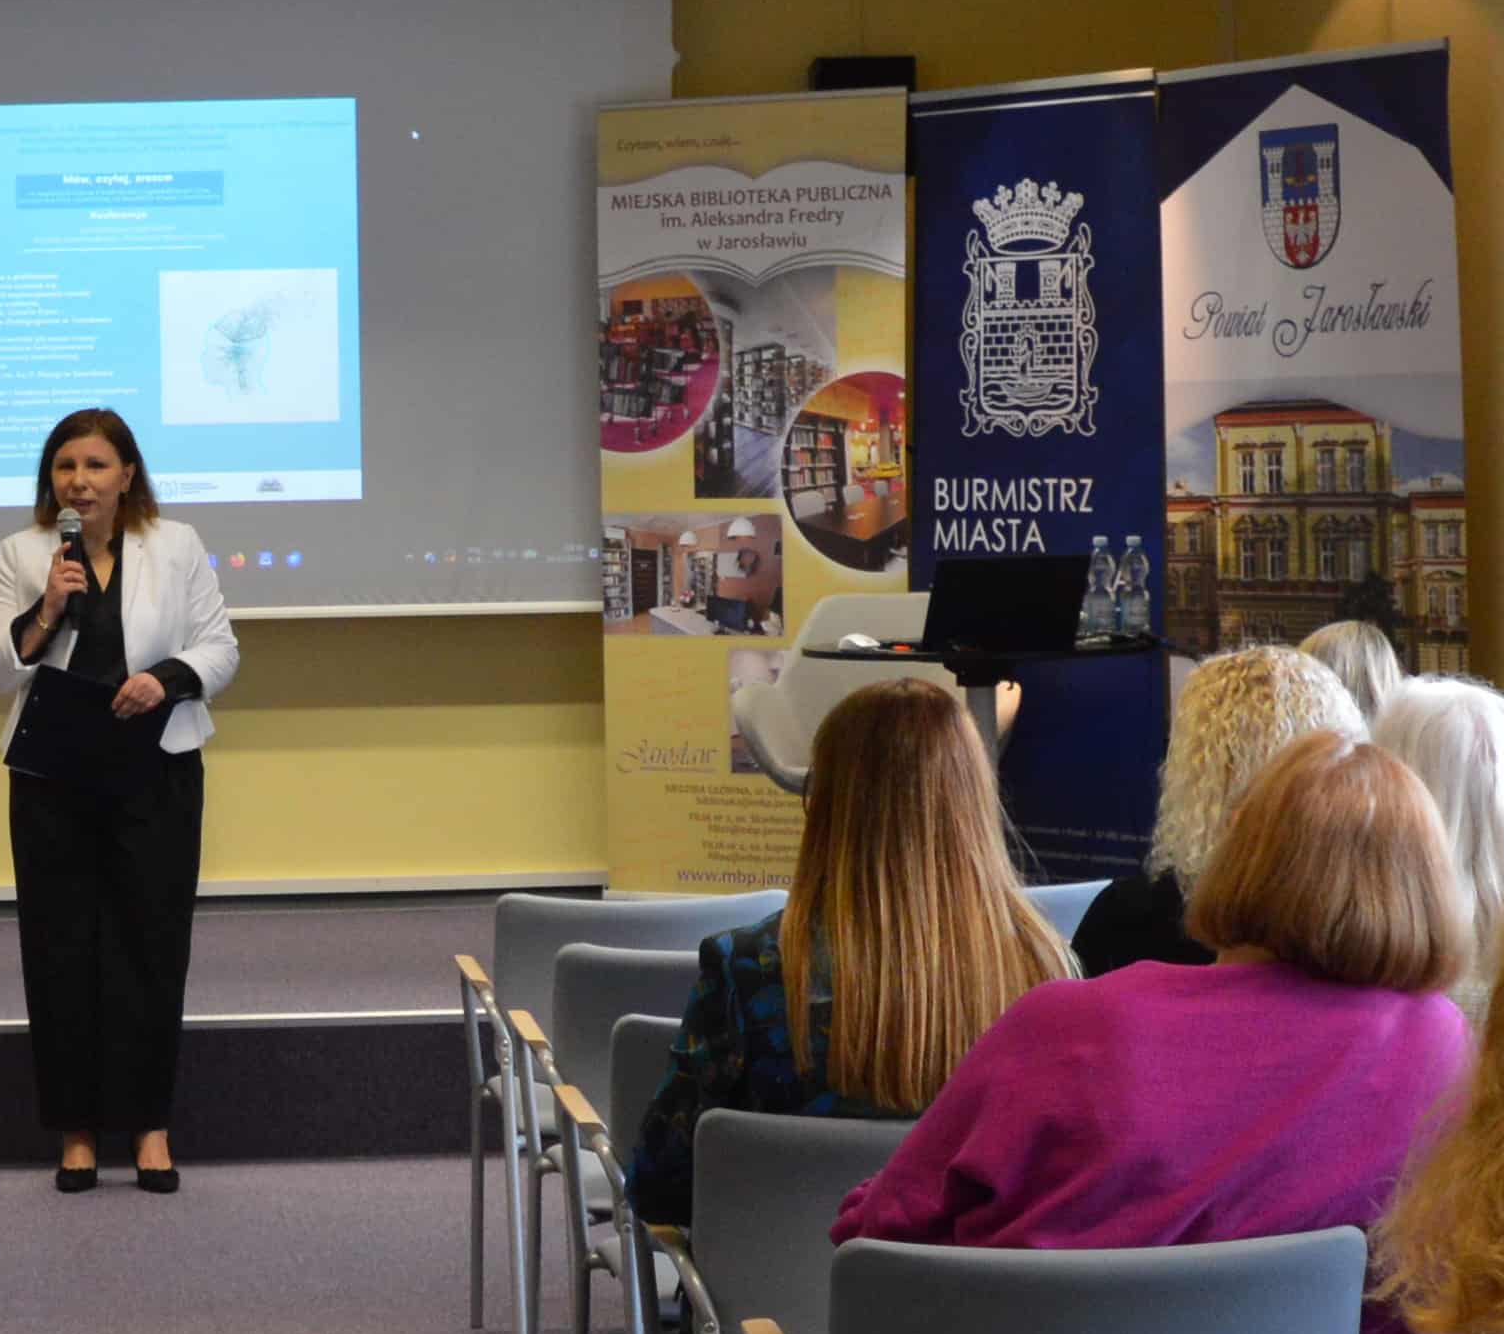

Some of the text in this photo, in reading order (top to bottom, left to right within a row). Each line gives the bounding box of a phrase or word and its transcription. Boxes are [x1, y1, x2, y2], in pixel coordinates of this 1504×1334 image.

[611, 184, 892, 211] MIEJSKA BIBLIOTEKA PUBLICZNA
[661, 207, 844, 228] im. Aleksandra Fredry
[697, 232, 807, 251] w Jarosławiu
[1183, 278, 1433, 357] Powiat Jarosławski
[933, 477, 1094, 513] BURMISTRZ
[933, 518, 1046, 554] MIASTA
[677, 868, 796, 888] www.mbp.jaro
